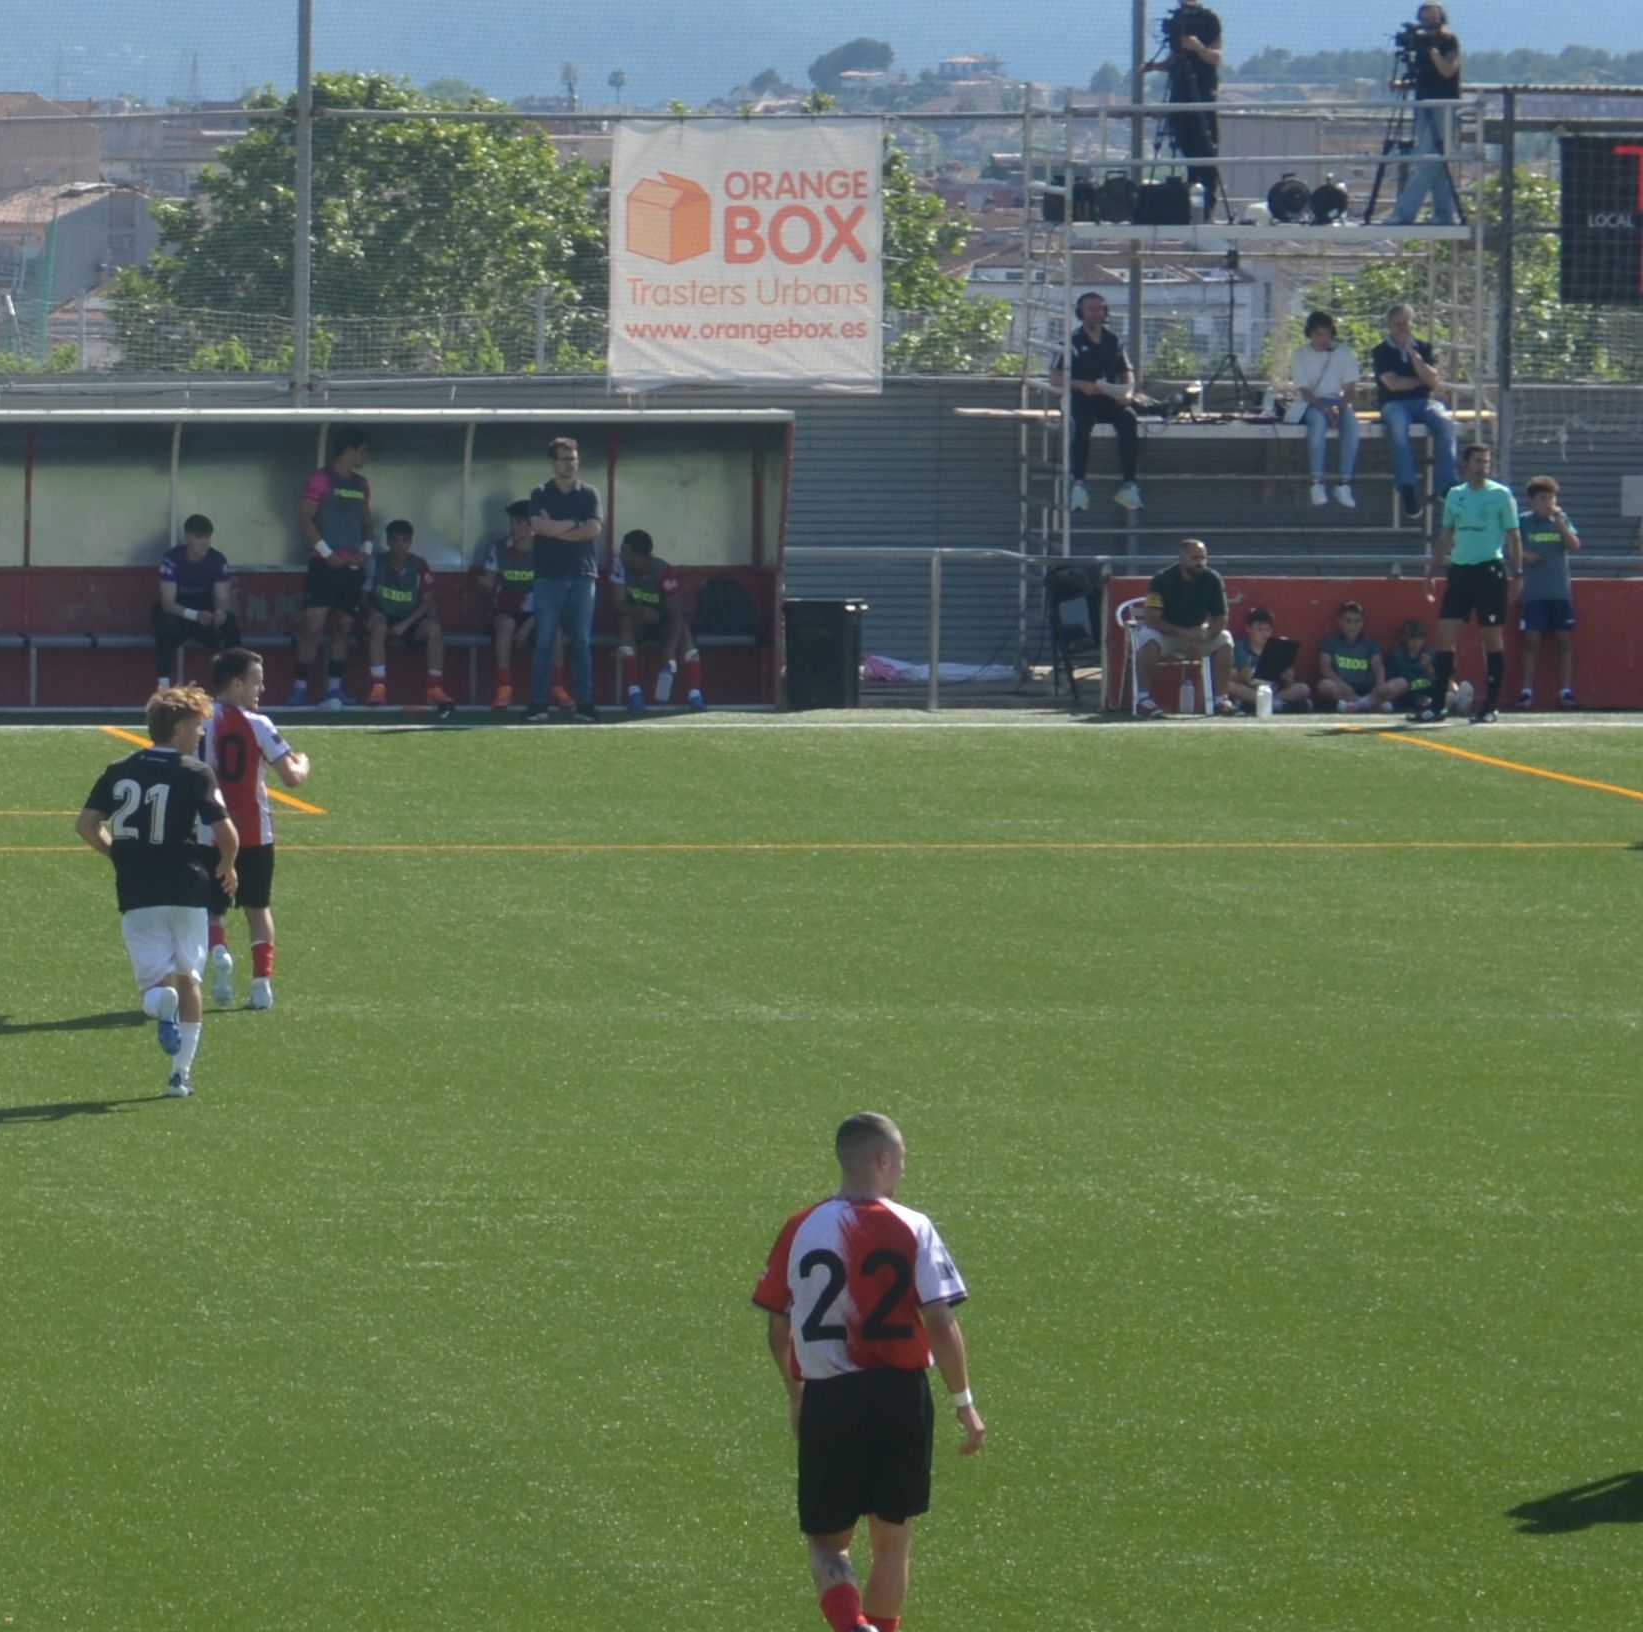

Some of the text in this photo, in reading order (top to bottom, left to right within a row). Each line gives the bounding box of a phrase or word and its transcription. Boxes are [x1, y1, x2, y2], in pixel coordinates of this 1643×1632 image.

[724, 170, 868, 200] ORANGE
[724, 204, 867, 265] BOX
[1587, 213, 1634, 228] LOCAL
[626, 276, 868, 306] Trasters Urbans
[625, 317, 868, 345] www.orangebox.es
[112, 778, 171, 845] 21
[798, 1247, 915, 1342] 22
